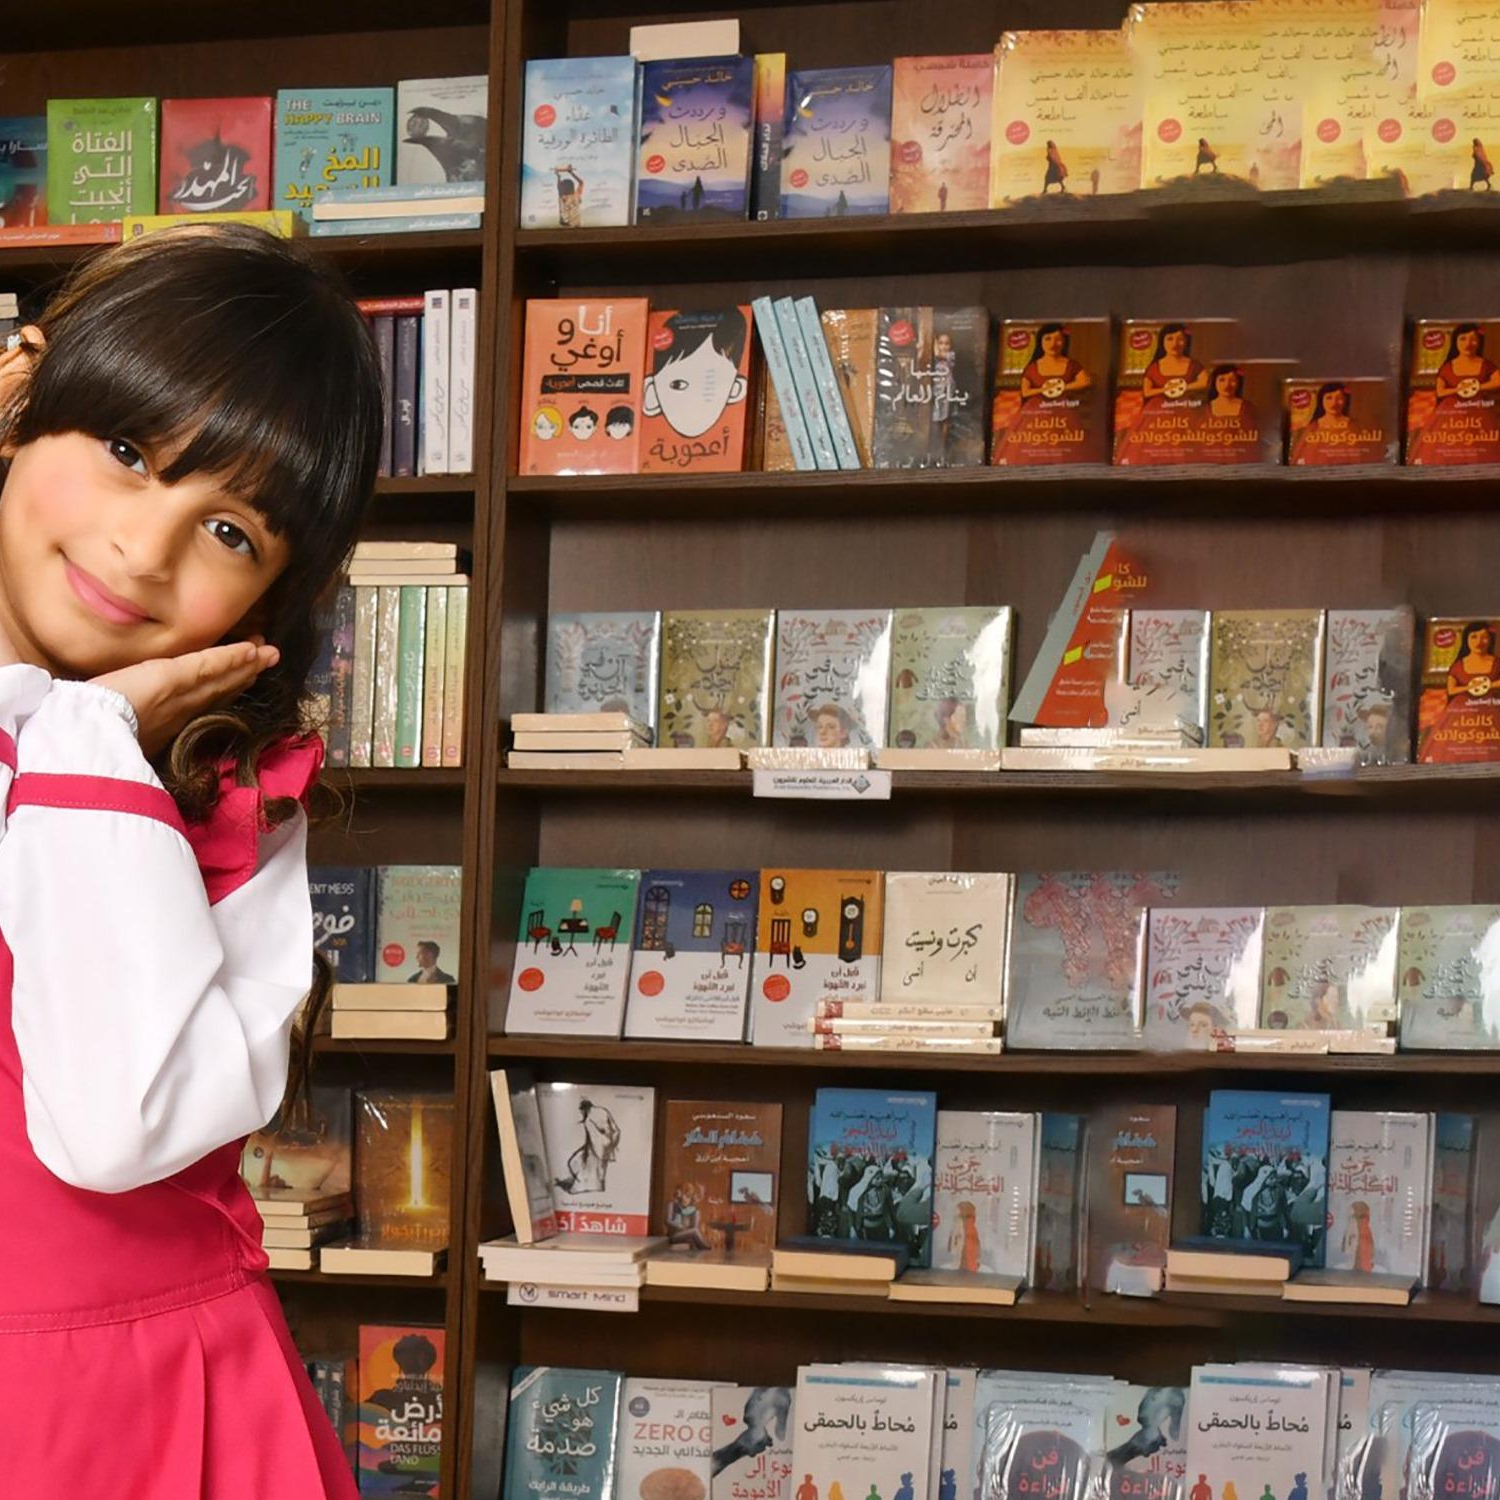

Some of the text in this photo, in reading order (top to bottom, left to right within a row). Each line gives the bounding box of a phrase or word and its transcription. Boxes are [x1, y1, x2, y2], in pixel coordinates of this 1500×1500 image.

[663, 70, 732, 91] خالد حسيني
[285, 100, 311, 111] THE
[284, 112, 381, 126] HAPPY BRAIN
[72, 131, 132, 153] الفتاة
[670, 124, 725, 149] الجبال
[813, 136, 867, 161] الجبال
[72, 156, 132, 185] التي
[322, 147, 380, 181] المخ
[671, 149, 728, 172] الصدى
[558, 305, 613, 345] أنا و
[551, 329, 624, 372] أوغي
[901, 359, 950, 382] بينما
[891, 385, 932, 411] العالم
[650, 426, 731, 467] أعجوبة
[904, 923, 983, 961] كبرت ونسيت
[965, 965, 978, 982] أن
[532, 1386, 602, 1423] كل شيء
[571, 1416, 594, 1431] هو
[633, 1423, 693, 1442] ZERO
[804, 1413, 867, 1436] بالحمقى
[1198, 1412, 1260, 1436] بالحمقى
[390, 1444, 412, 1454] DAS
[527, 1428, 596, 1457] صدمة
[633, 1445, 670, 1457] الجديد
[390, 1455, 419, 1465] LAND
